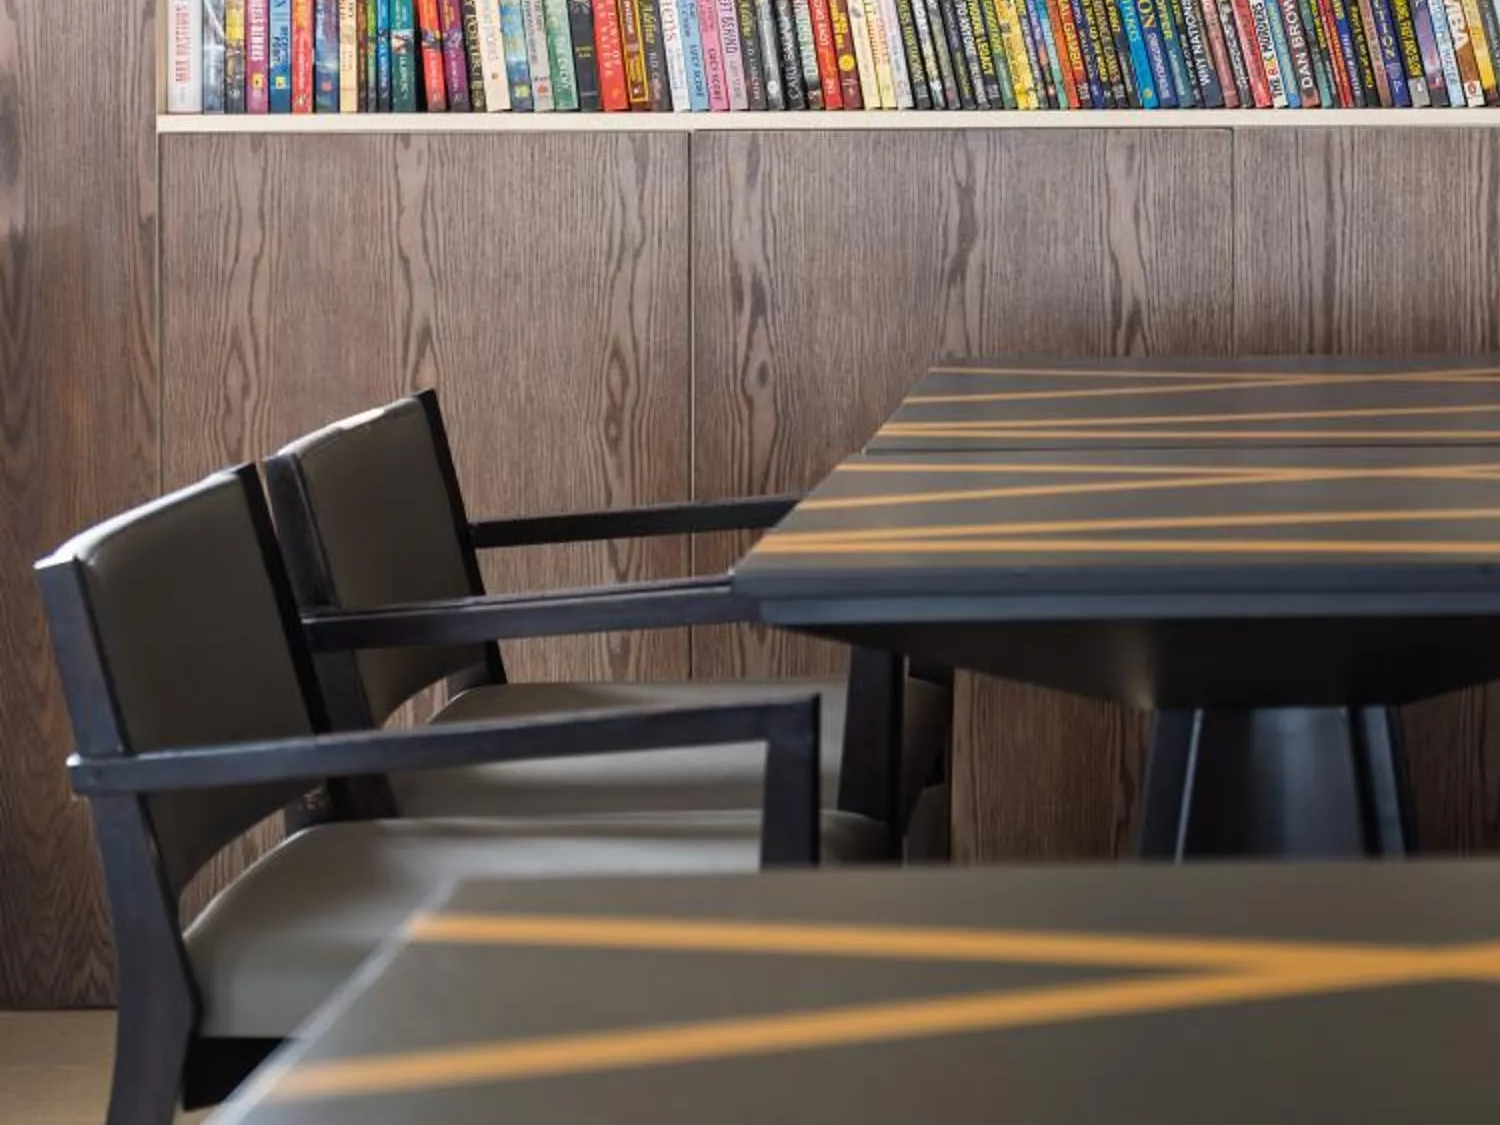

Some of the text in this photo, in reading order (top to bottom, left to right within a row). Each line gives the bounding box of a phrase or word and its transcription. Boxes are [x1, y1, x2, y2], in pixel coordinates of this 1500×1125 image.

[466, 14, 483, 76] POTTER
[607, 13, 618, 45] LAWS
[721, 16, 738, 54] BEHIND
[958, 17, 976, 56] ANYONE
[1063, 21, 1082, 73] GAMBIT
[1252, 3, 1274, 52] MURDERS
[976, 37, 994, 77] LEGACY
[1196, 56, 1212, 86] WHY
[1295, 51, 1313, 89] DAN
